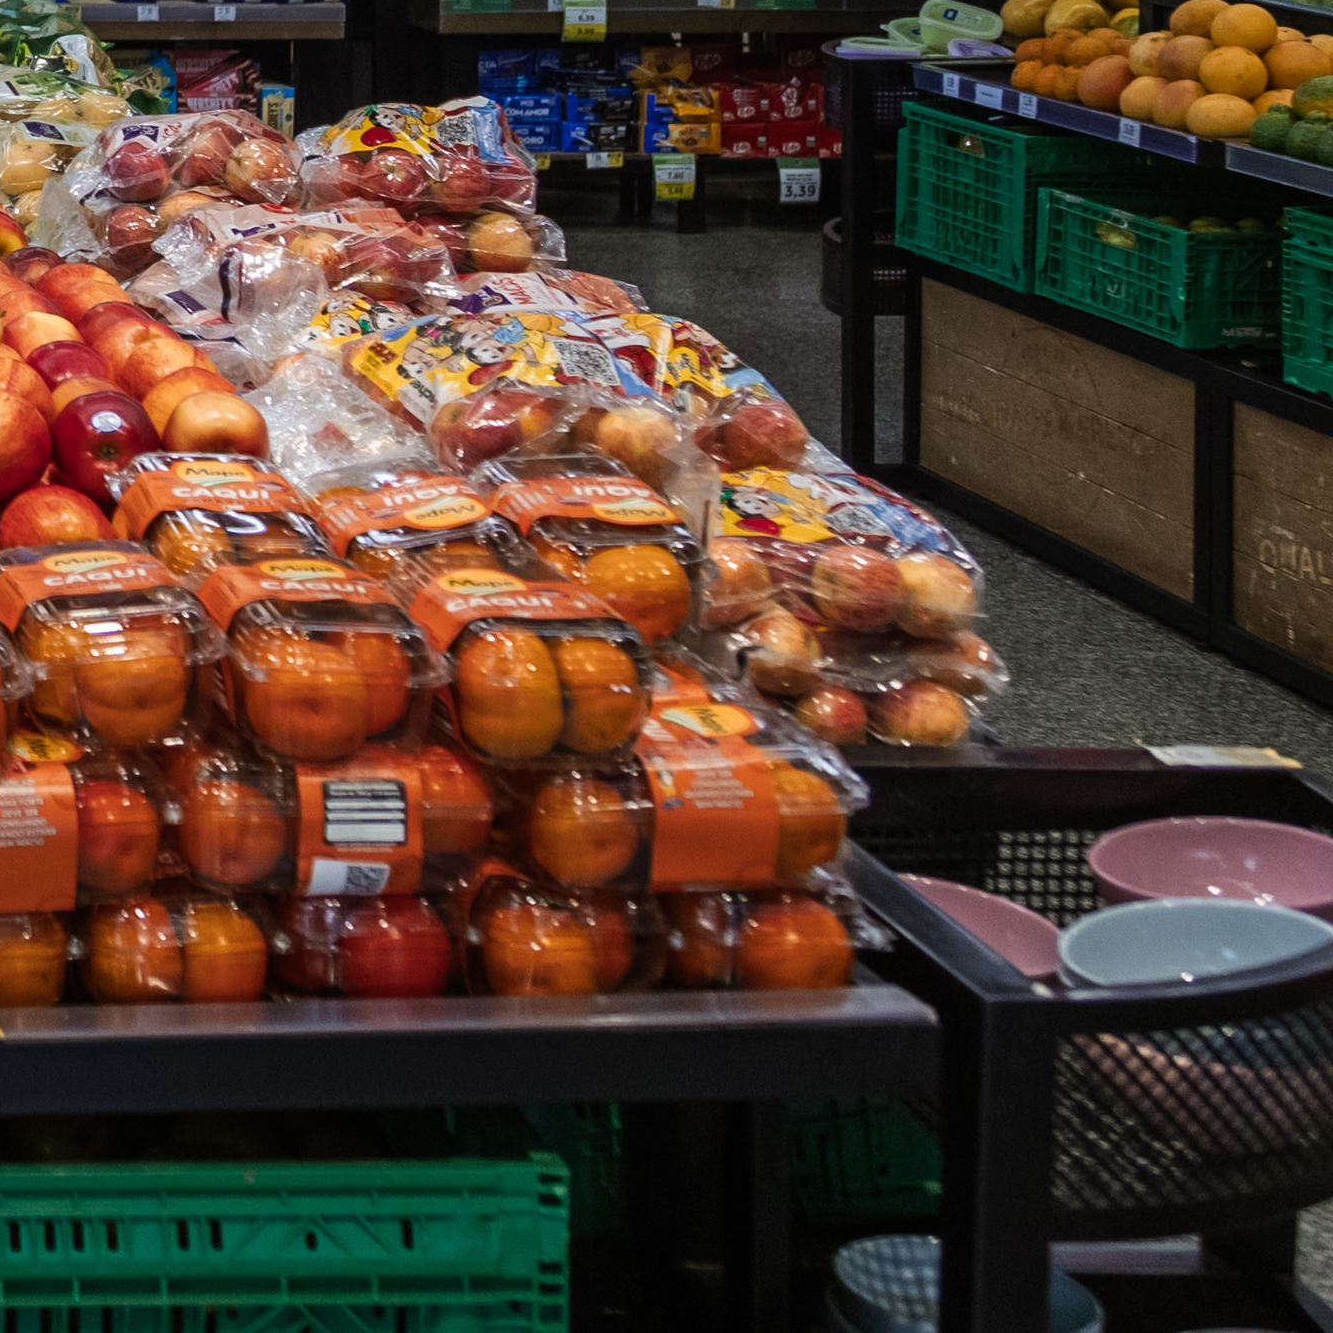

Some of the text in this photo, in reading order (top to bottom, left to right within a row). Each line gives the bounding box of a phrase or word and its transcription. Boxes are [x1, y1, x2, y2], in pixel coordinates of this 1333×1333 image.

[187, 98, 233, 111] HERSHEY'S
[524, 108, 550, 117] AMOR
[784, 186, 817, 199] 3,39
[184, 466, 247, 479] Mape
[172, 486, 271, 501] CAQUI
[572, 484, 653, 499] AQUI
[54, 552, 119, 566] Mape
[269, 563, 334, 575] Mape
[43, 568, 147, 587] CAQUI
[260, 580, 368, 596] CAQUI
[449, 578, 517, 593] Mape
[446, 594, 553, 614] CAQUI
